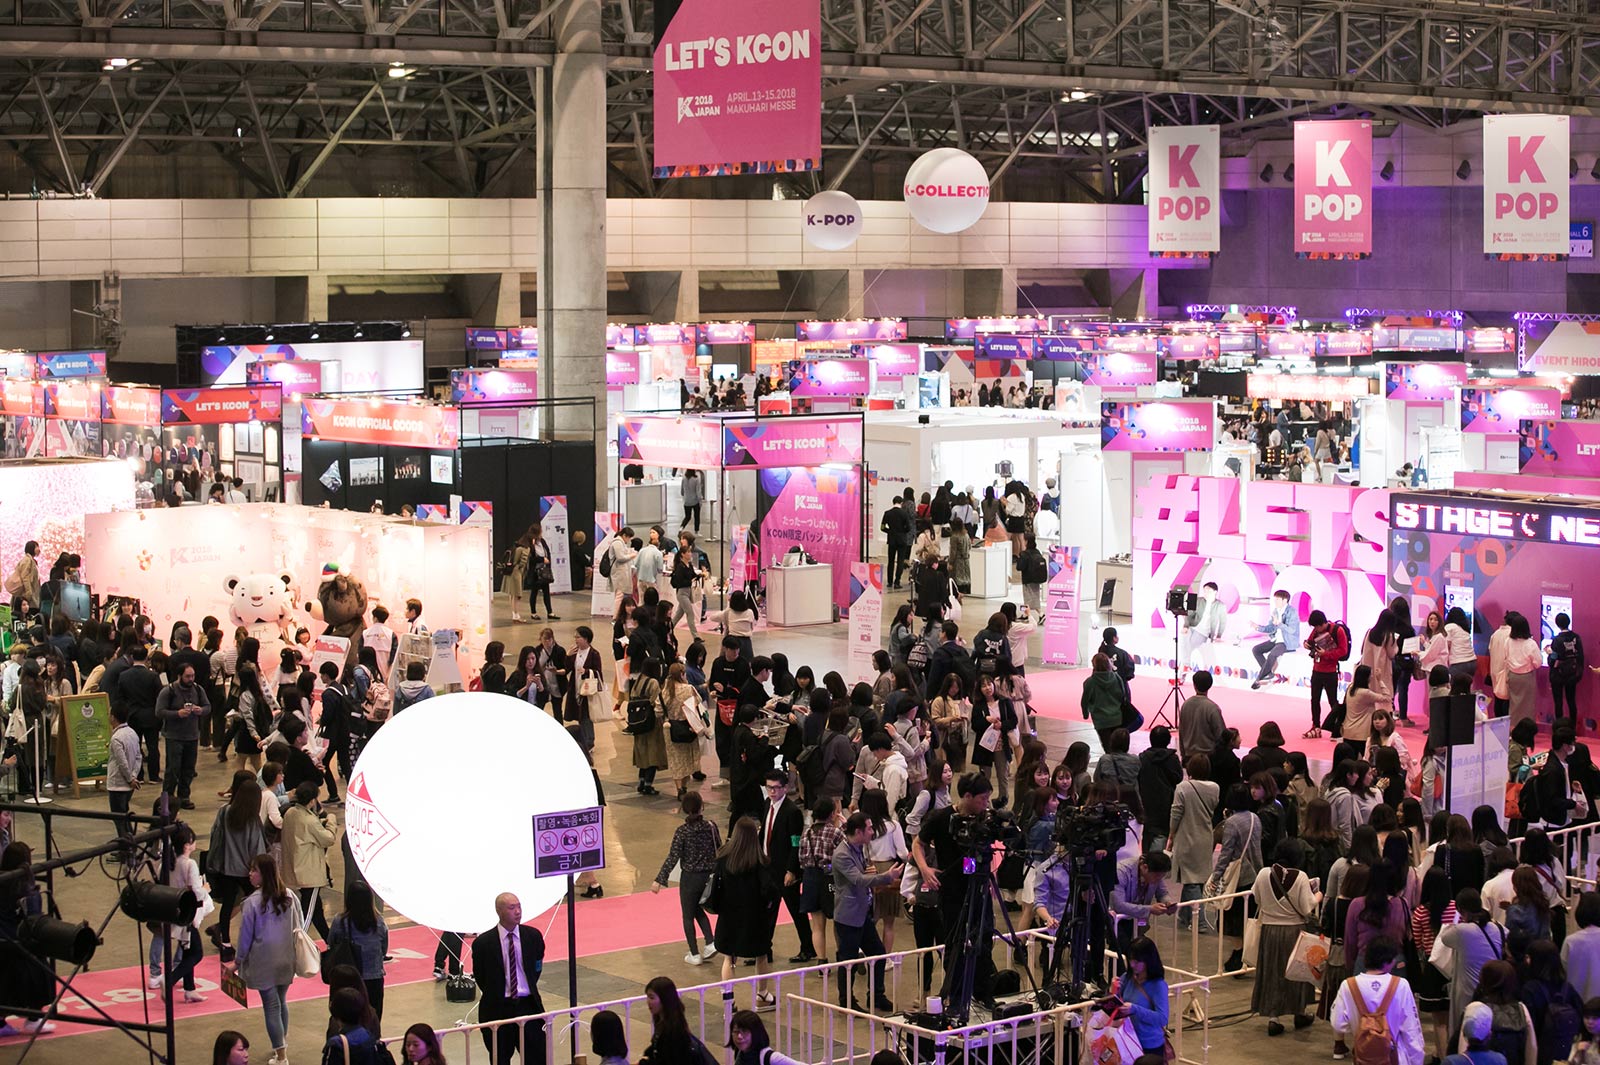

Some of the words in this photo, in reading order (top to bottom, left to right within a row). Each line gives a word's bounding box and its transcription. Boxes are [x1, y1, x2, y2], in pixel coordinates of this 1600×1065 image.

[665, 36, 731, 71] LET'S
[736, 29, 810, 65] KCON
[695, 95, 713, 106] 2018
[727, 105, 768, 115] MAKUHARI
[769, 100, 796, 112] MESSE
[695, 106, 721, 117] JAPAN
[1168, 144, 1201, 188] K
[1315, 140, 1352, 187] K
[1507, 135, 1547, 183] K
[1158, 195, 1211, 221] POP
[1304, 193, 1363, 221] POP
[1495, 192, 1559, 220] POP
[807, 214, 855, 226] K-POP
[1582, 225, 1589, 237] 6
[1535, 356, 1569, 366] EVENT
[344, 371, 378, 385] DAY
[196, 402, 221, 411] LET'S
[222, 401, 250, 411] KCON
[333, 415, 356, 428] KCON
[357, 416, 392, 431] OFFICIAL
[392, 418, 424, 433] GOODS
[1178, 424, 1208, 432] JAPAN
[763, 439, 792, 451] LET'S
[794, 437, 825, 449] KCON
[782, 516, 839, 530] たった一つしかない
[1396, 502, 1515, 538] STAGE
[558, 852, 582, 870] 금지
